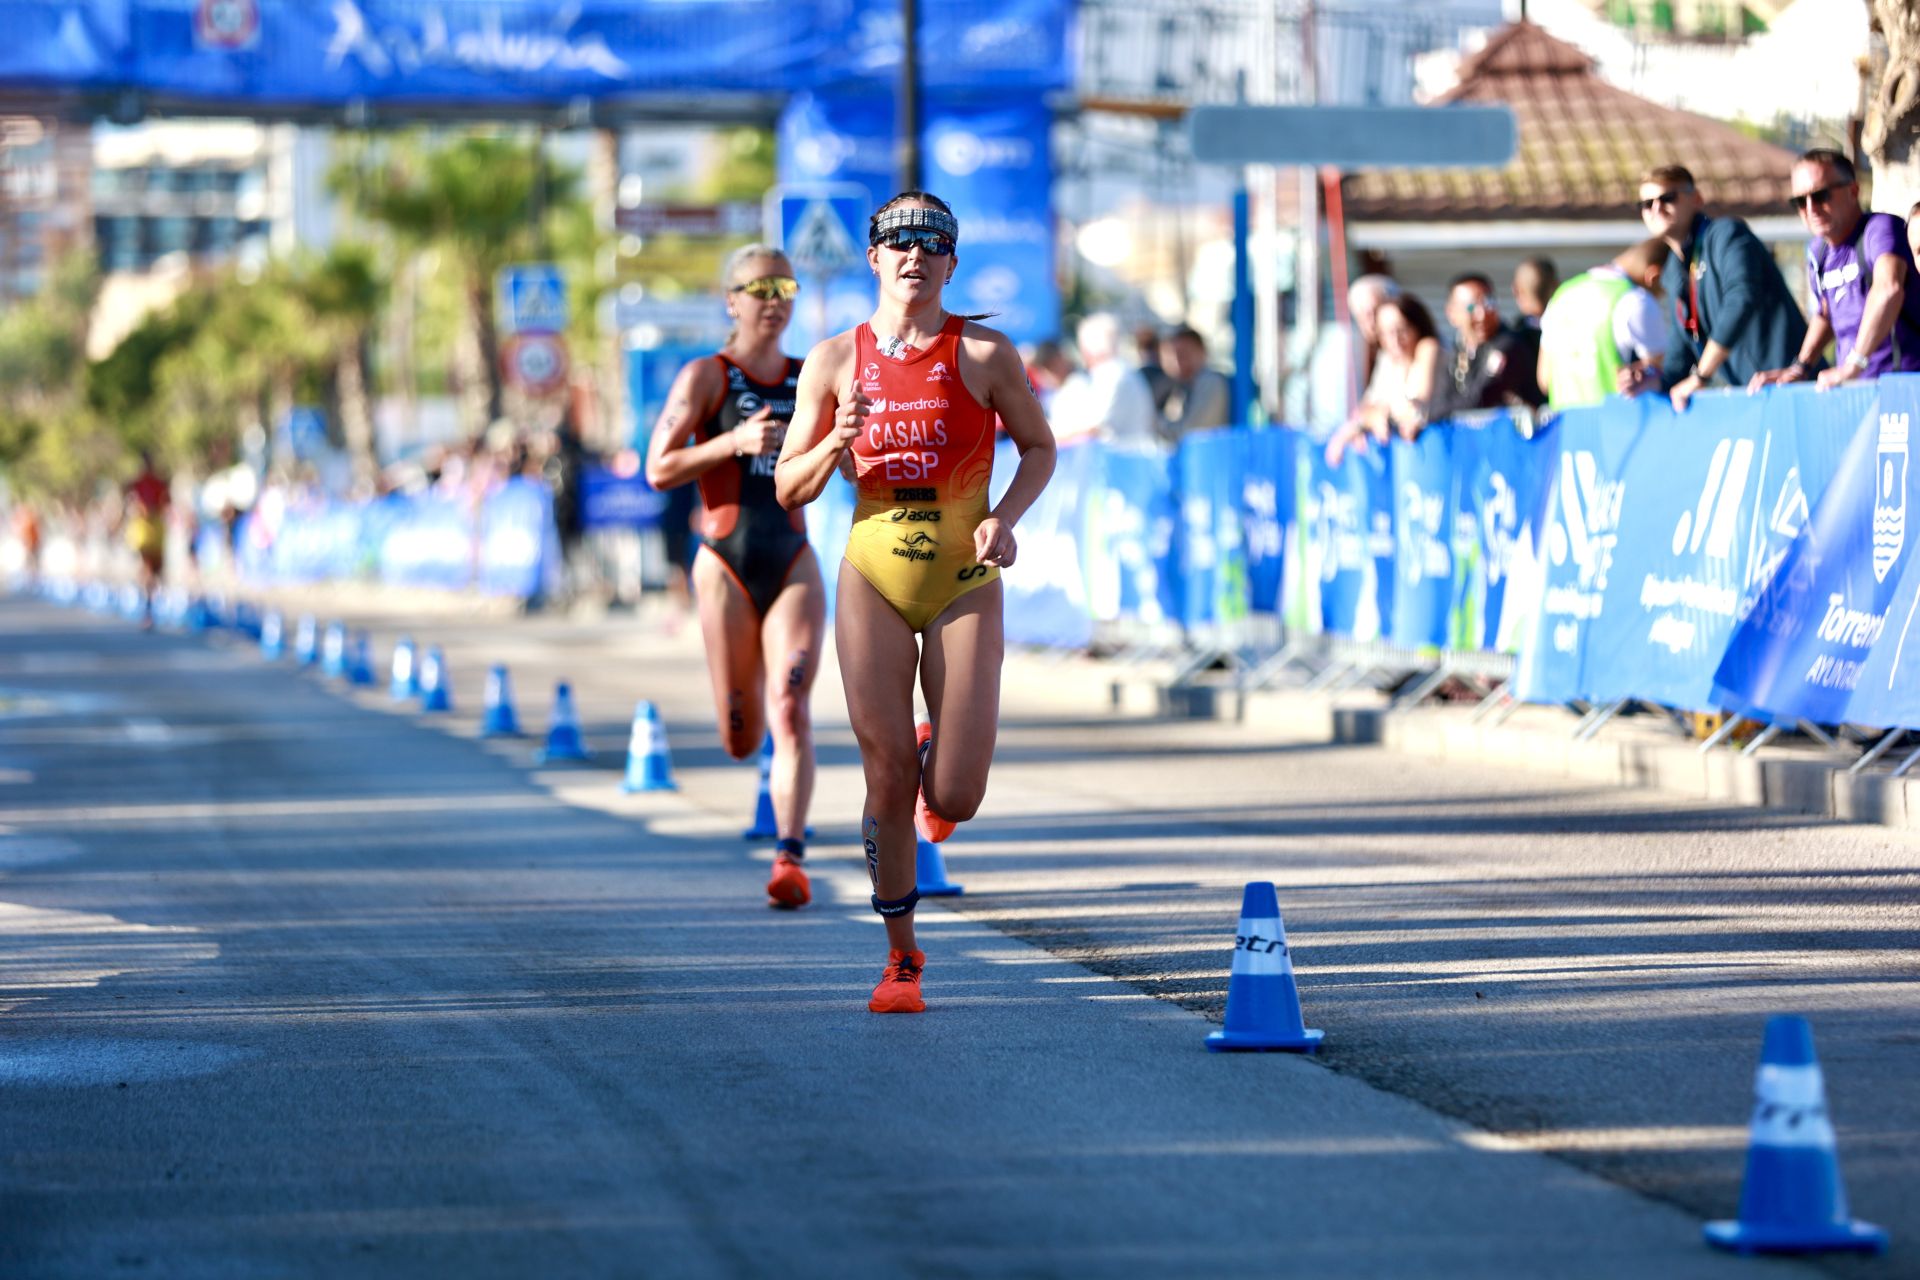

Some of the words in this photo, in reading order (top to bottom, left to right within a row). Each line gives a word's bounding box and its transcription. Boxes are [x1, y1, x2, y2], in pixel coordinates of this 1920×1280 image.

[888, 396, 950, 412] Iberdrola
[869, 418, 948, 450] CASALS
[884, 451, 940, 480] ESP
[907, 510, 942, 522] asics
[892, 547, 936, 562] sailfish
